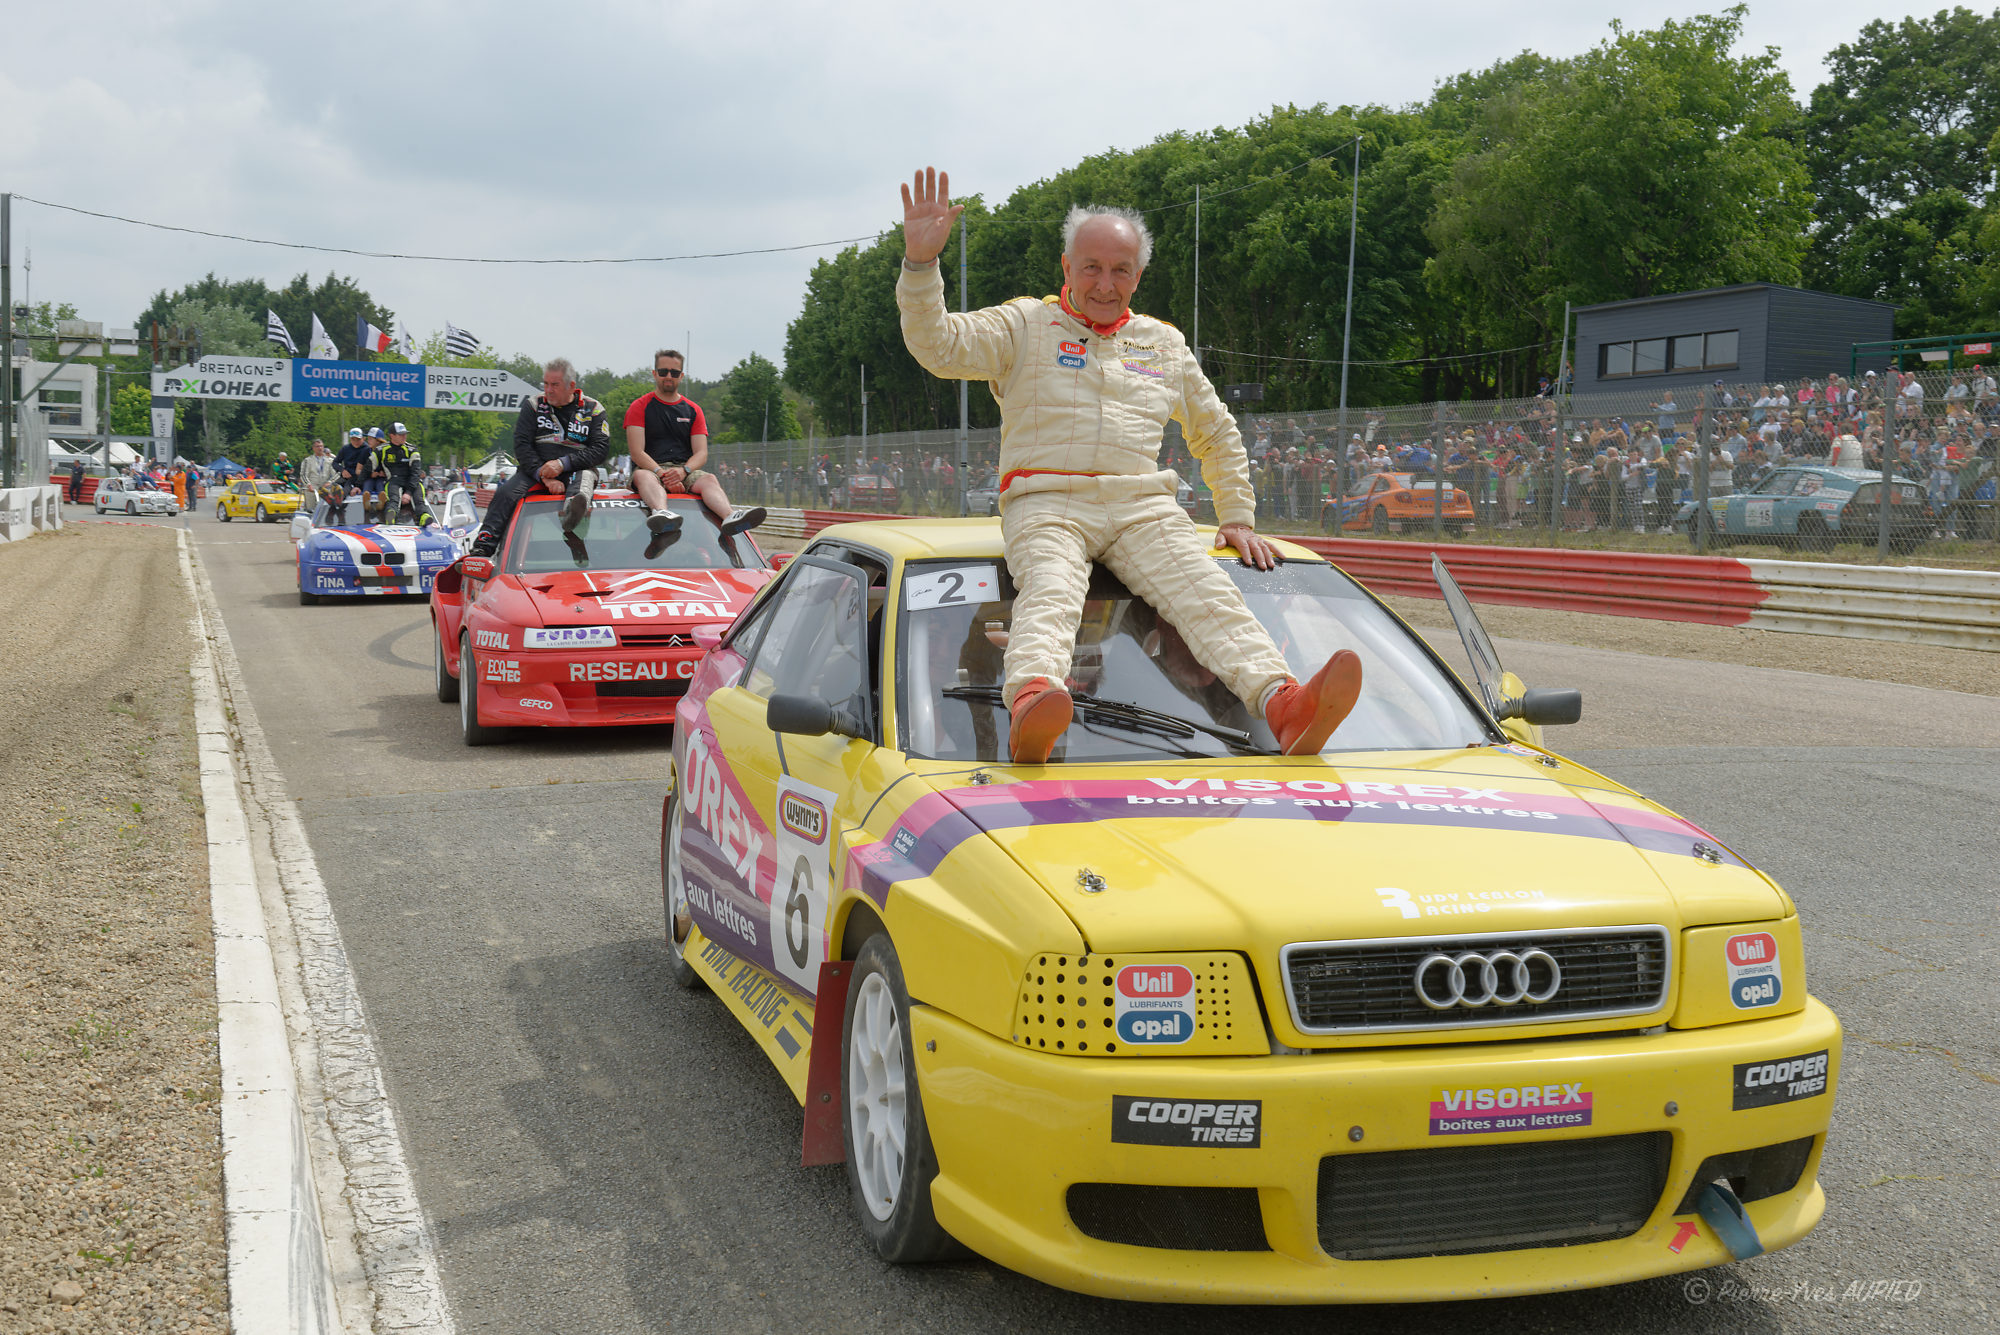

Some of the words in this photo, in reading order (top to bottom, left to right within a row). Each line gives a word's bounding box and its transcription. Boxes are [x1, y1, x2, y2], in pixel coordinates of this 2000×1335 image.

[1065, 343, 1080, 353] Unil
[200, 362, 273, 376] BRETAGNE
[1062, 357, 1081, 367] opal
[301, 363, 419, 386] Communiquez
[428, 374, 497, 387] BRETAGNE
[310, 387, 348, 399] avec
[353, 385, 410, 402] Lohéac
[317, 575, 345, 588] FINA
[937, 572, 966, 604] 2
[601, 602, 738, 619] TOTAL
[476, 630, 510, 649] TOTAL
[536, 628, 612, 641] EUROPA
[570, 661, 668, 682] RESEAU
[519, 698, 553, 710] GEFCO
[1145, 778, 1515, 802] VISOREX
[1293, 799, 1384, 809] aux
[1396, 800, 1559, 820] lettres
[1468, 890, 1545, 900] LEBLON
[686, 881, 712, 916] aux
[711, 889, 757, 946] lettres
[784, 854, 814, 970] 6
[1736, 939, 1766, 961] Unil
[1737, 966, 1774, 976] LUBRIFIANTS
[1133, 972, 1173, 993] Unil
[1741, 978, 1774, 1004] opal
[728, 964, 790, 1029] RACING
[1129, 1000, 1183, 1008] LUBRIFIANTS
[1131, 1014, 1181, 1041] opal
[1744, 1054, 1828, 1088] COOPER
[1787, 1075, 1826, 1097] TIRES
[1441, 1082, 1584, 1112] VISOREX
[1127, 1101, 1258, 1126] COOPER
[1439, 1119, 1491, 1131] boîtes
[1495, 1117, 1527, 1129] aux
[1531, 1113, 1583, 1127] lettres
[1191, 1126, 1255, 1143] TIRES
